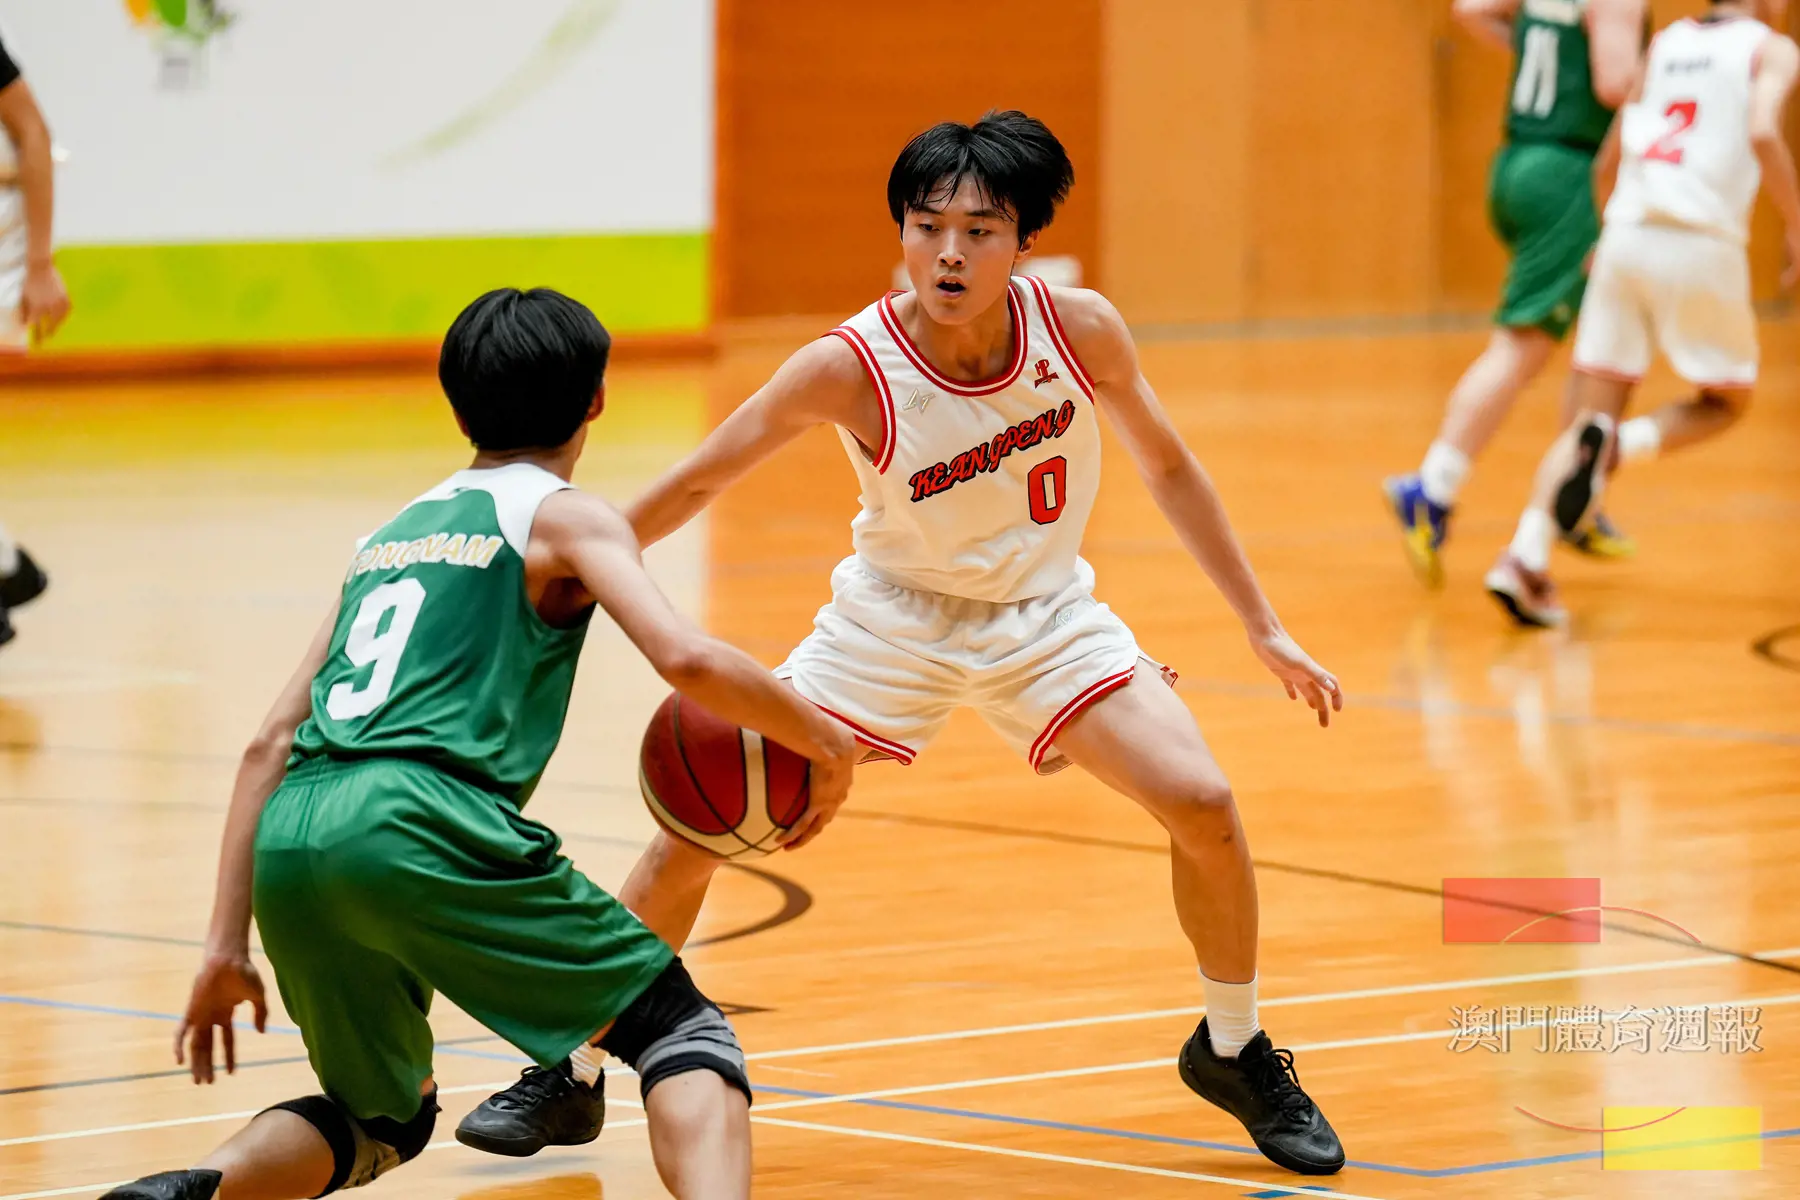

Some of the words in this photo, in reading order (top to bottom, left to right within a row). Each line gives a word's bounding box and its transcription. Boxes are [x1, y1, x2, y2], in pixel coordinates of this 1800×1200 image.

[1642, 98, 1698, 165] 2
[908, 399, 1076, 503] KEANGPENG
[1027, 455, 1067, 525] 0
[325, 577, 427, 721] 9
